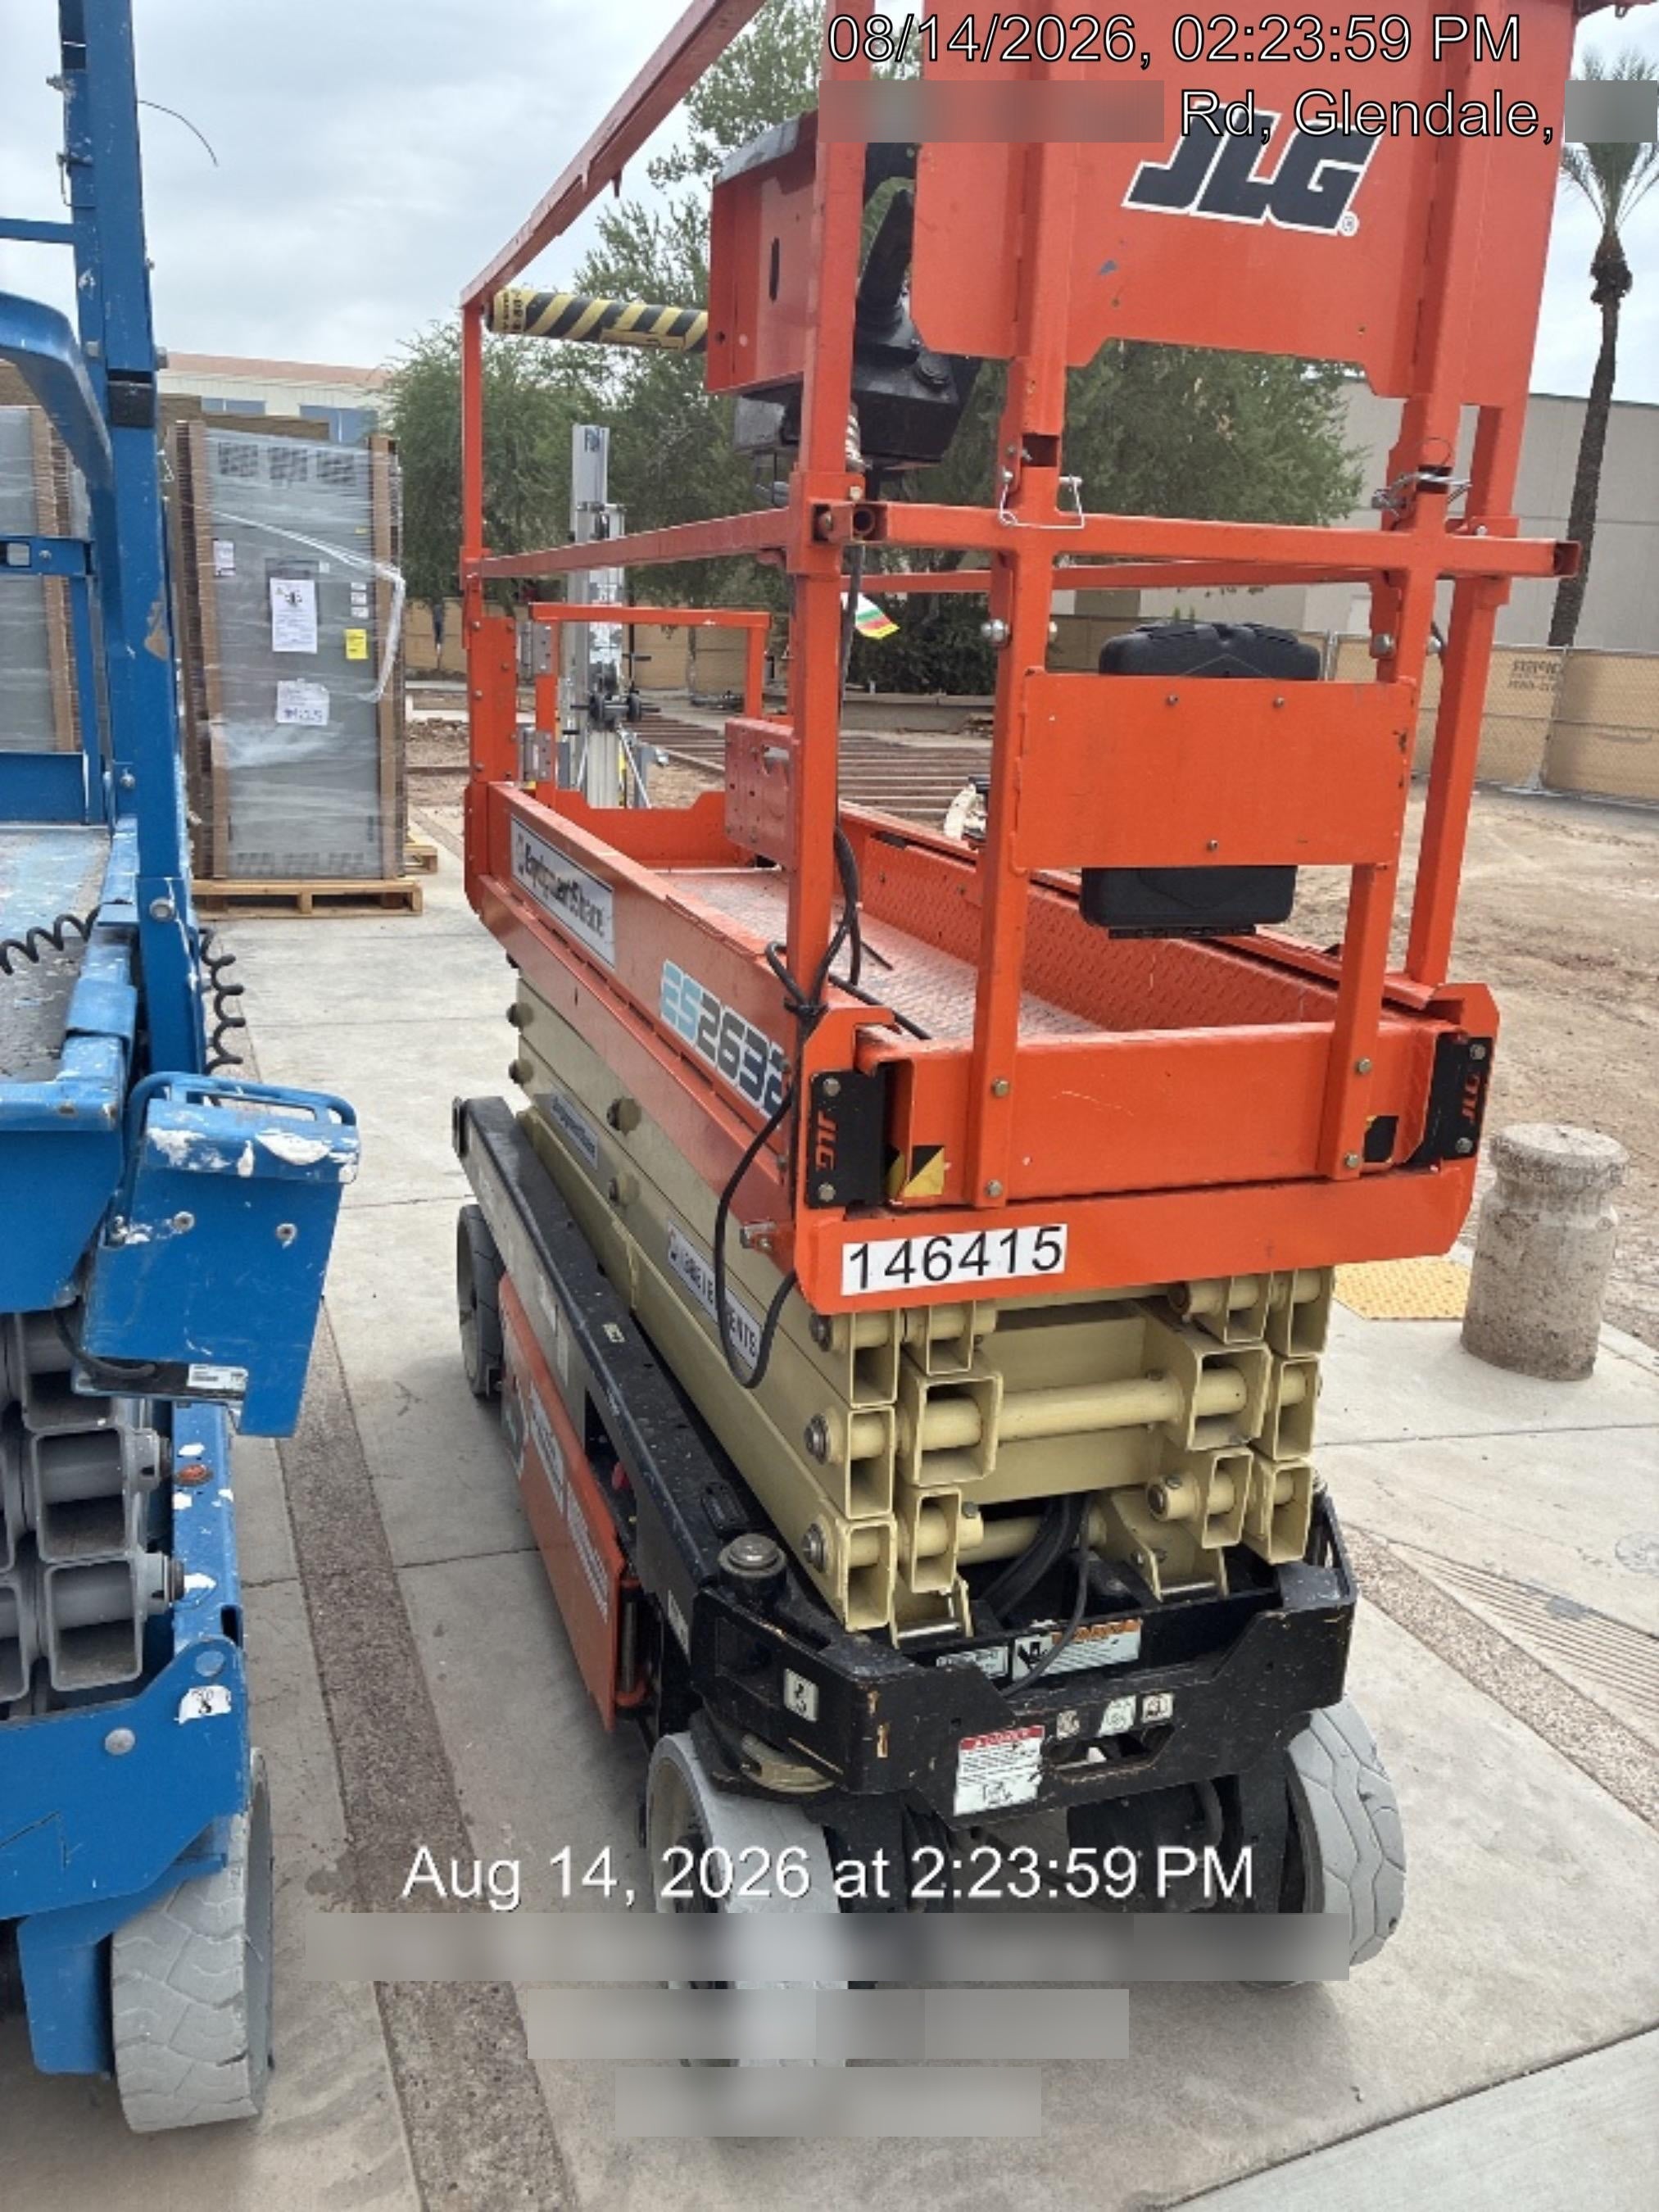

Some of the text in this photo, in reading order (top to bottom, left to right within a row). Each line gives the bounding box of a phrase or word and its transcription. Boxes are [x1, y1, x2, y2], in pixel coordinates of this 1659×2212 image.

[1123, 101, 1383, 236] JLG
[816, 1109, 836, 1172] JLG
[849, 1226, 1063, 1290] 146415
